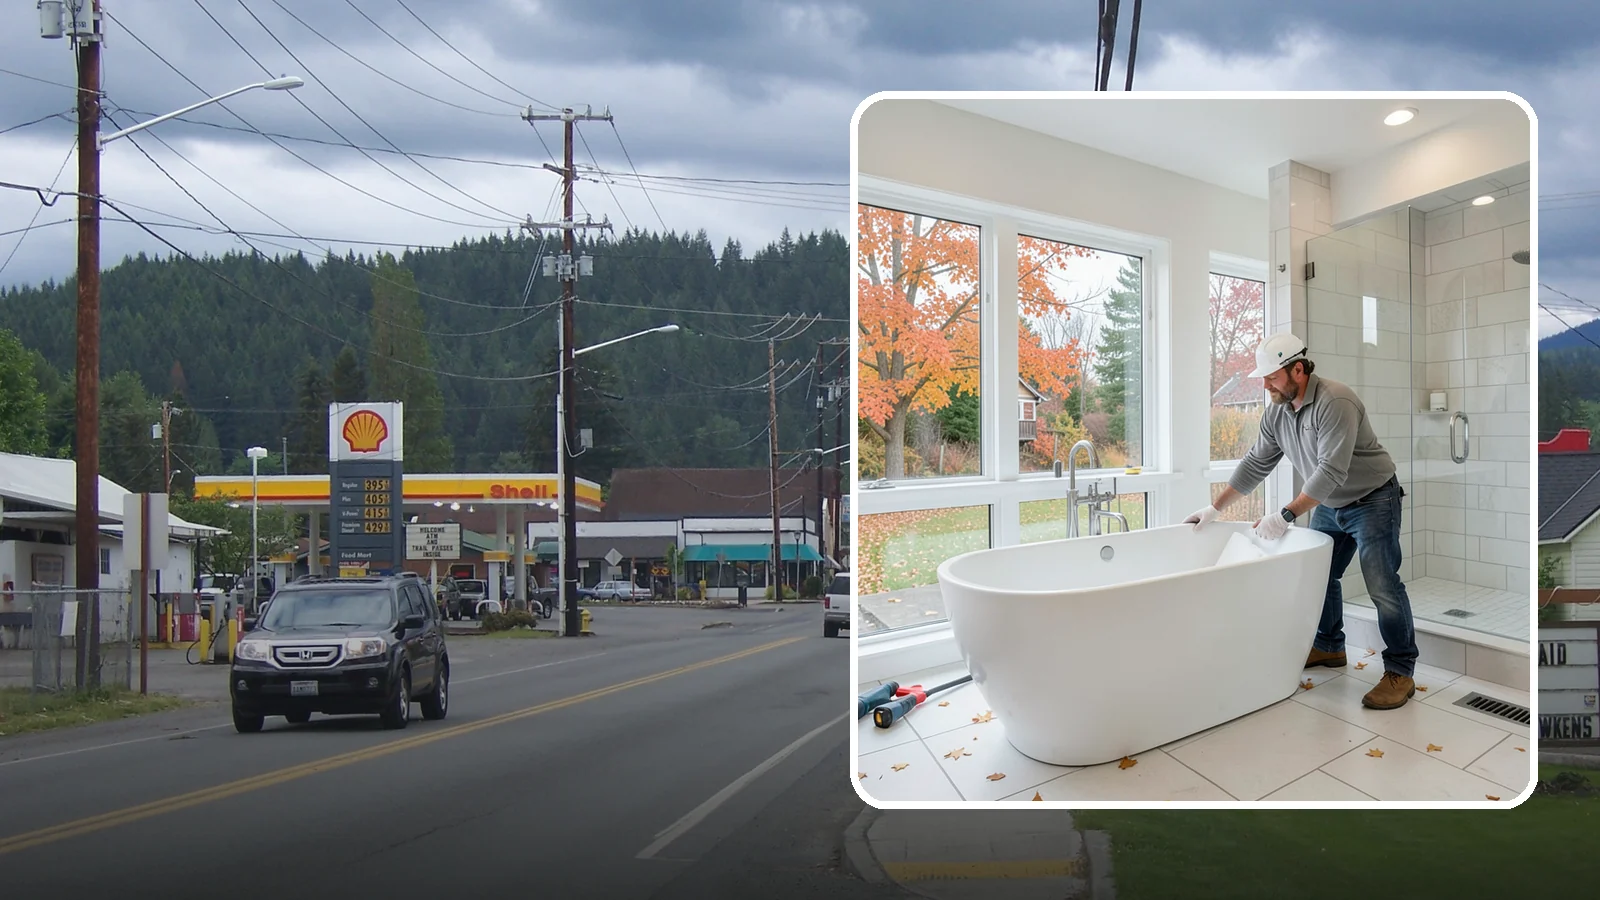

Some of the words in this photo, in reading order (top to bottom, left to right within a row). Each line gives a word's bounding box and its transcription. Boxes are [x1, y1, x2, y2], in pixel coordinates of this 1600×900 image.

[366, 480, 383, 490] 395
[490, 484, 547, 499] Shell
[366, 494, 383, 504] 405
[366, 508, 383, 518] 415
[366, 522, 383, 532] 429
[1538, 642, 1566, 666] AID
[1538, 716, 1592, 738] WKENS
